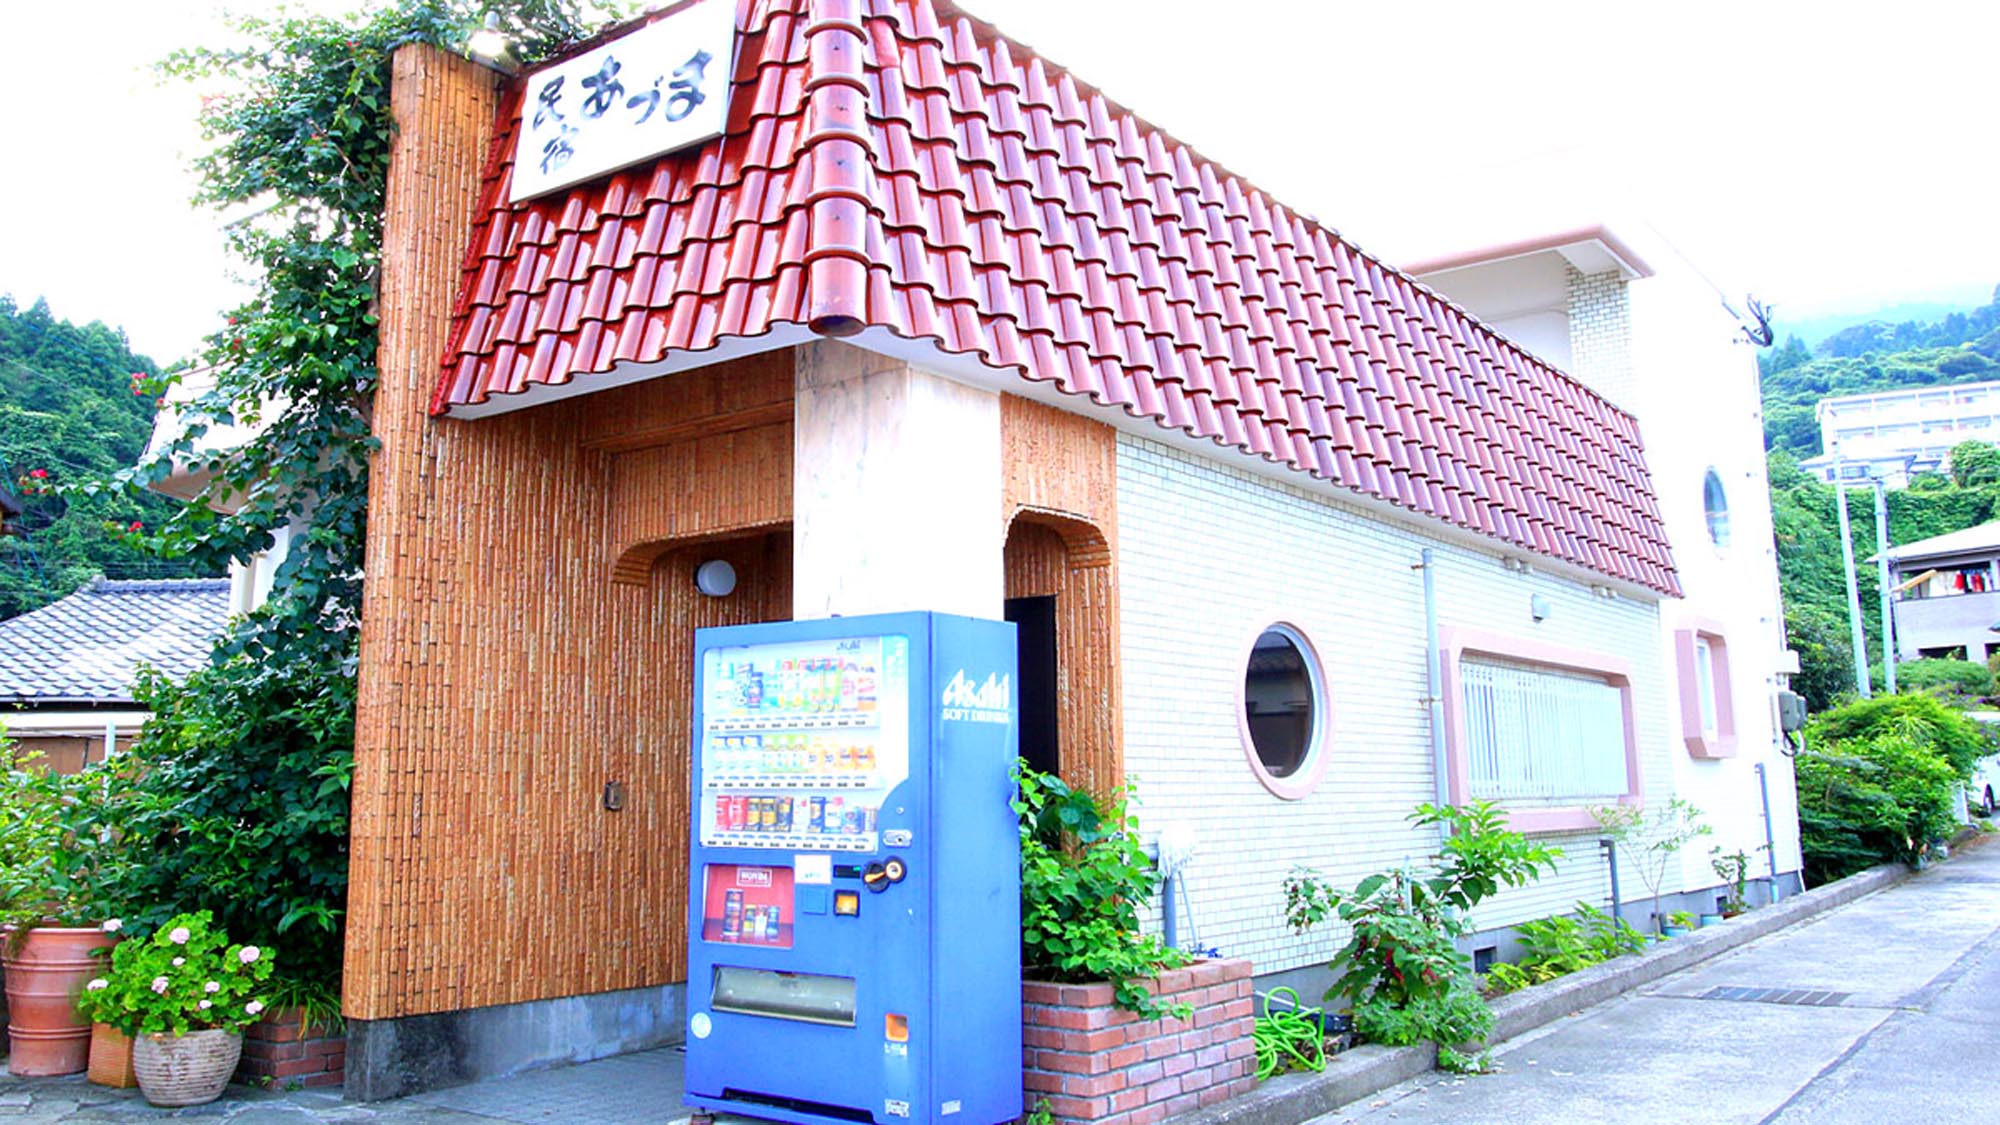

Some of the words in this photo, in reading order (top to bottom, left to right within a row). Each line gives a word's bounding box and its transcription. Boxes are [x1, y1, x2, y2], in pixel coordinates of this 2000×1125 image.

[532, 75, 579, 175] 民宿
[942, 668, 1009, 710] Asahi
[943, 708, 971, 721] SOFT
